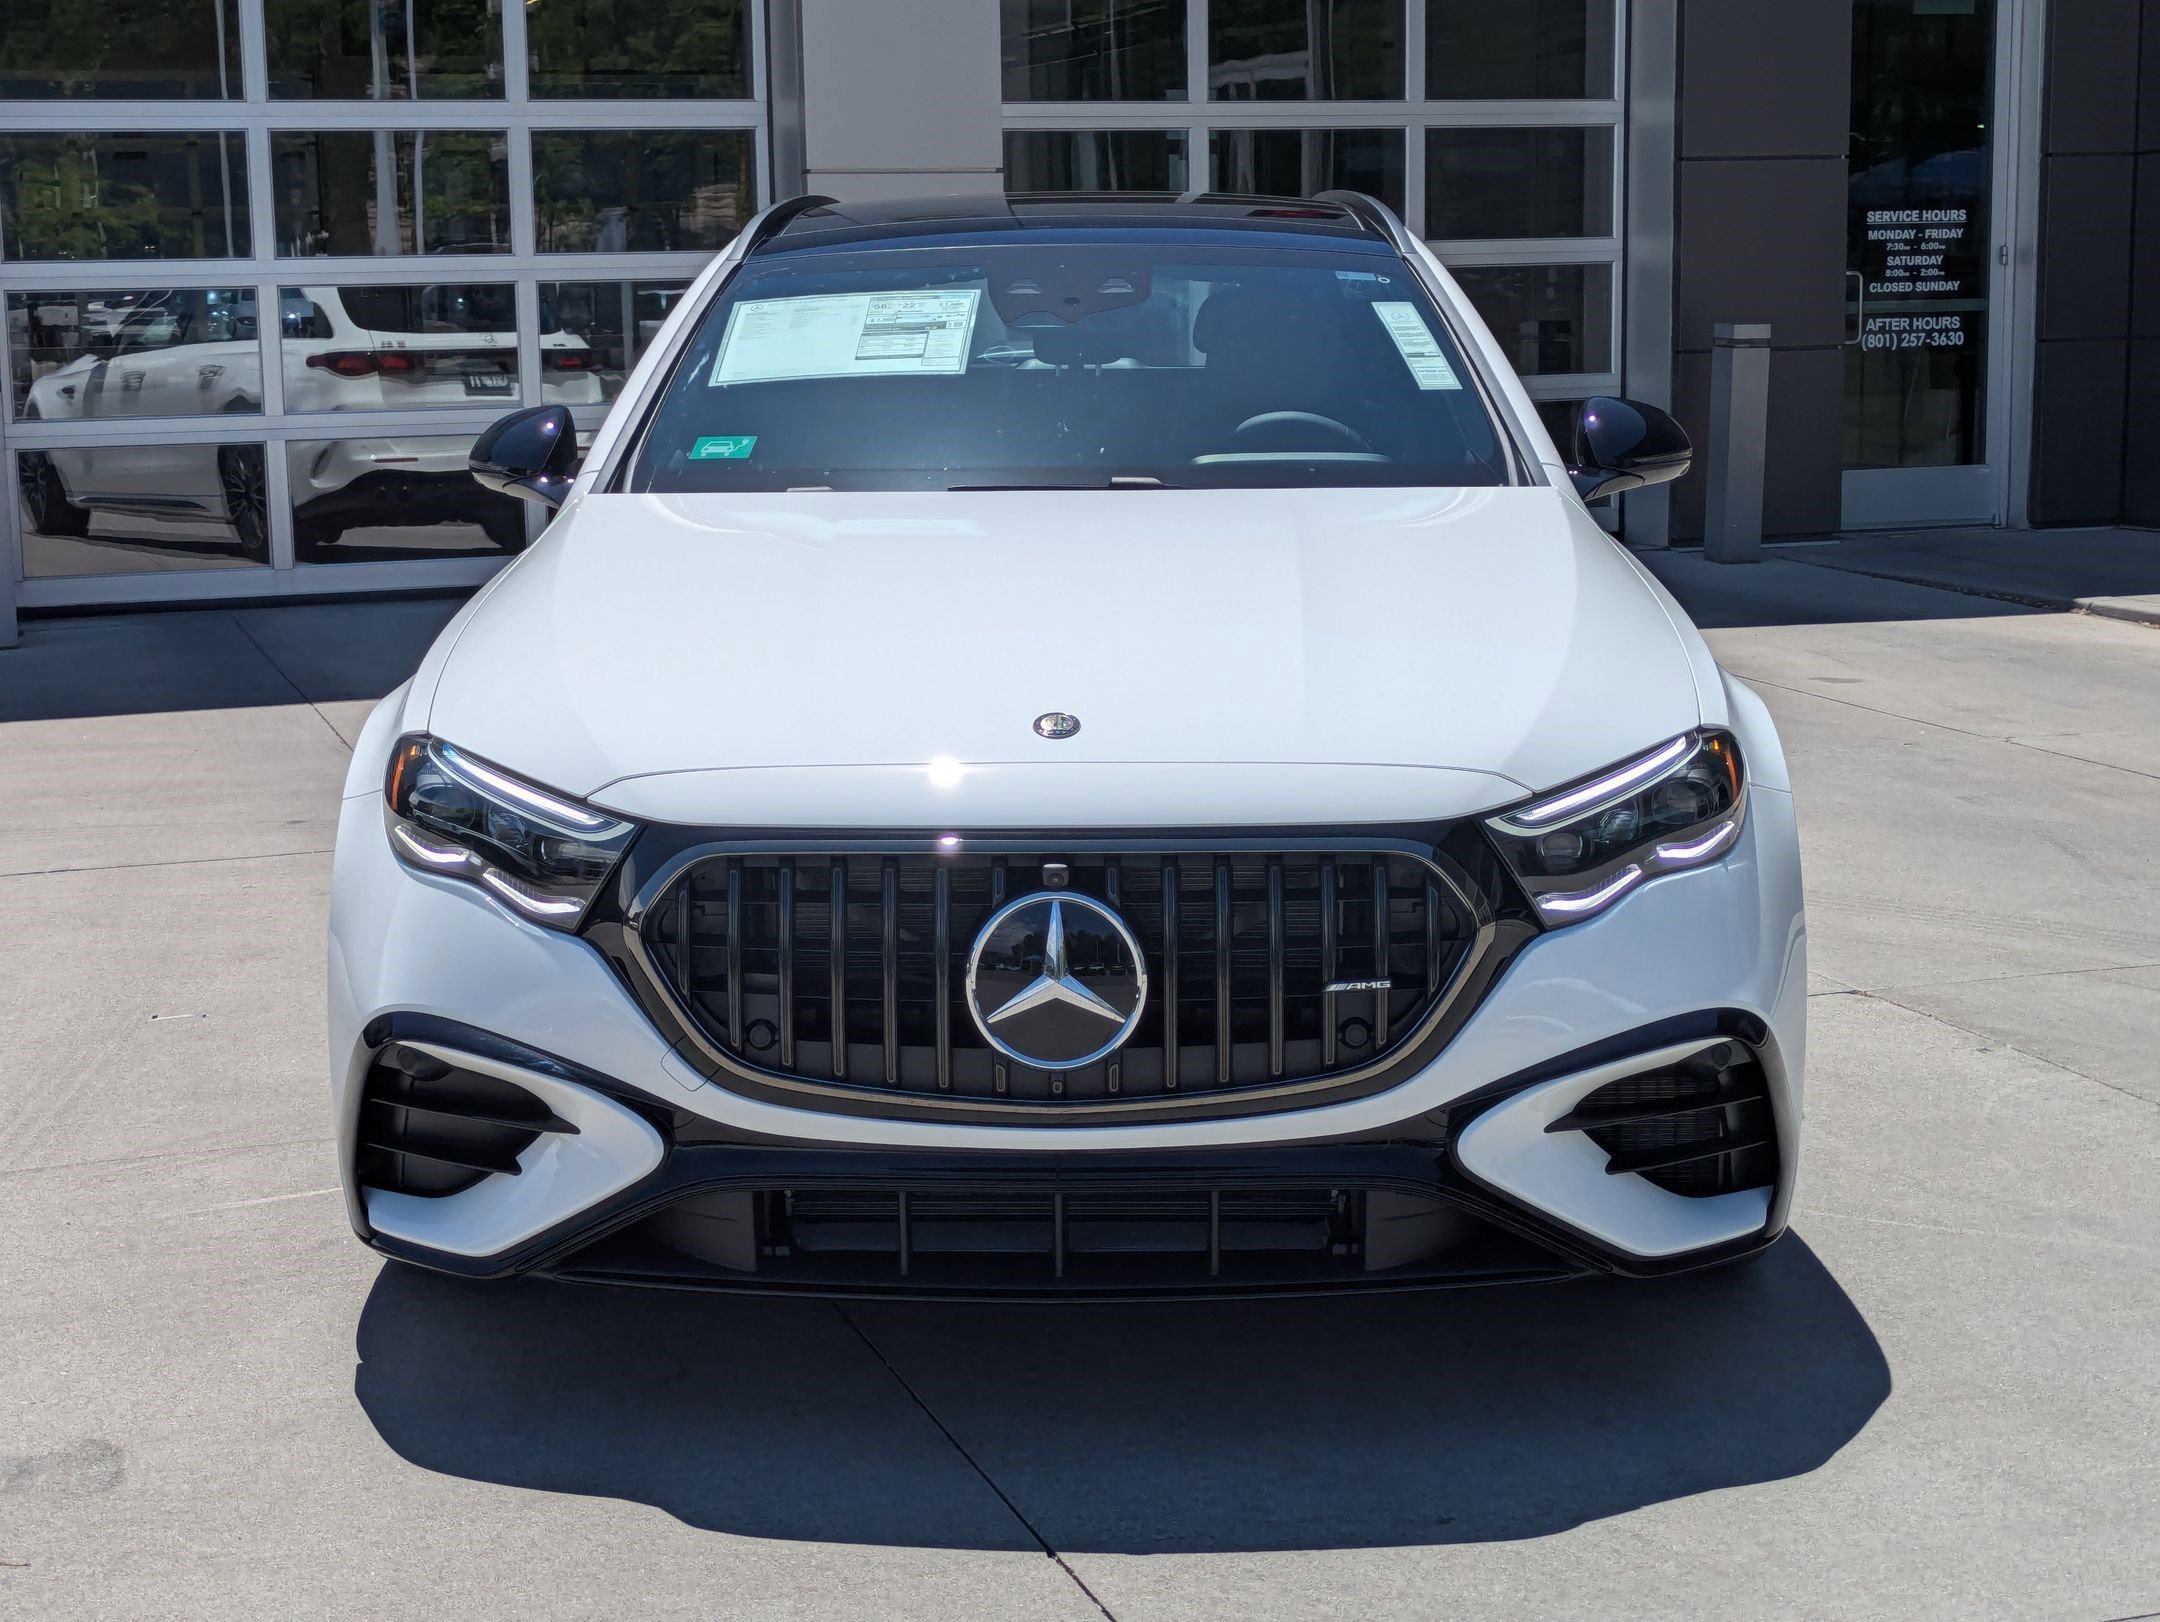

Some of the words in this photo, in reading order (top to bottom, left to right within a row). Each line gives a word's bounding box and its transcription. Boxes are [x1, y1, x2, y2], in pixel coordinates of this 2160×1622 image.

[1867, 211, 1920, 222] SERVICE
[1922, 209, 1967, 221] HOURS
[1868, 229, 1916, 240] MONDAY
[1925, 228, 1964, 239] FRIDAY
[1887, 255, 1944, 266] SATURDAY
[1869, 282, 1913, 293] CLOSED
[1915, 281, 1960, 292] SUNDAY
[1866, 318, 1910, 331] AFTER
[1913, 316, 1960, 330] HOURS
[1861, 333, 1898, 351] (801)
[1900, 331, 1965, 347] 257-3630
[1346, 981, 1391, 991] AMG
